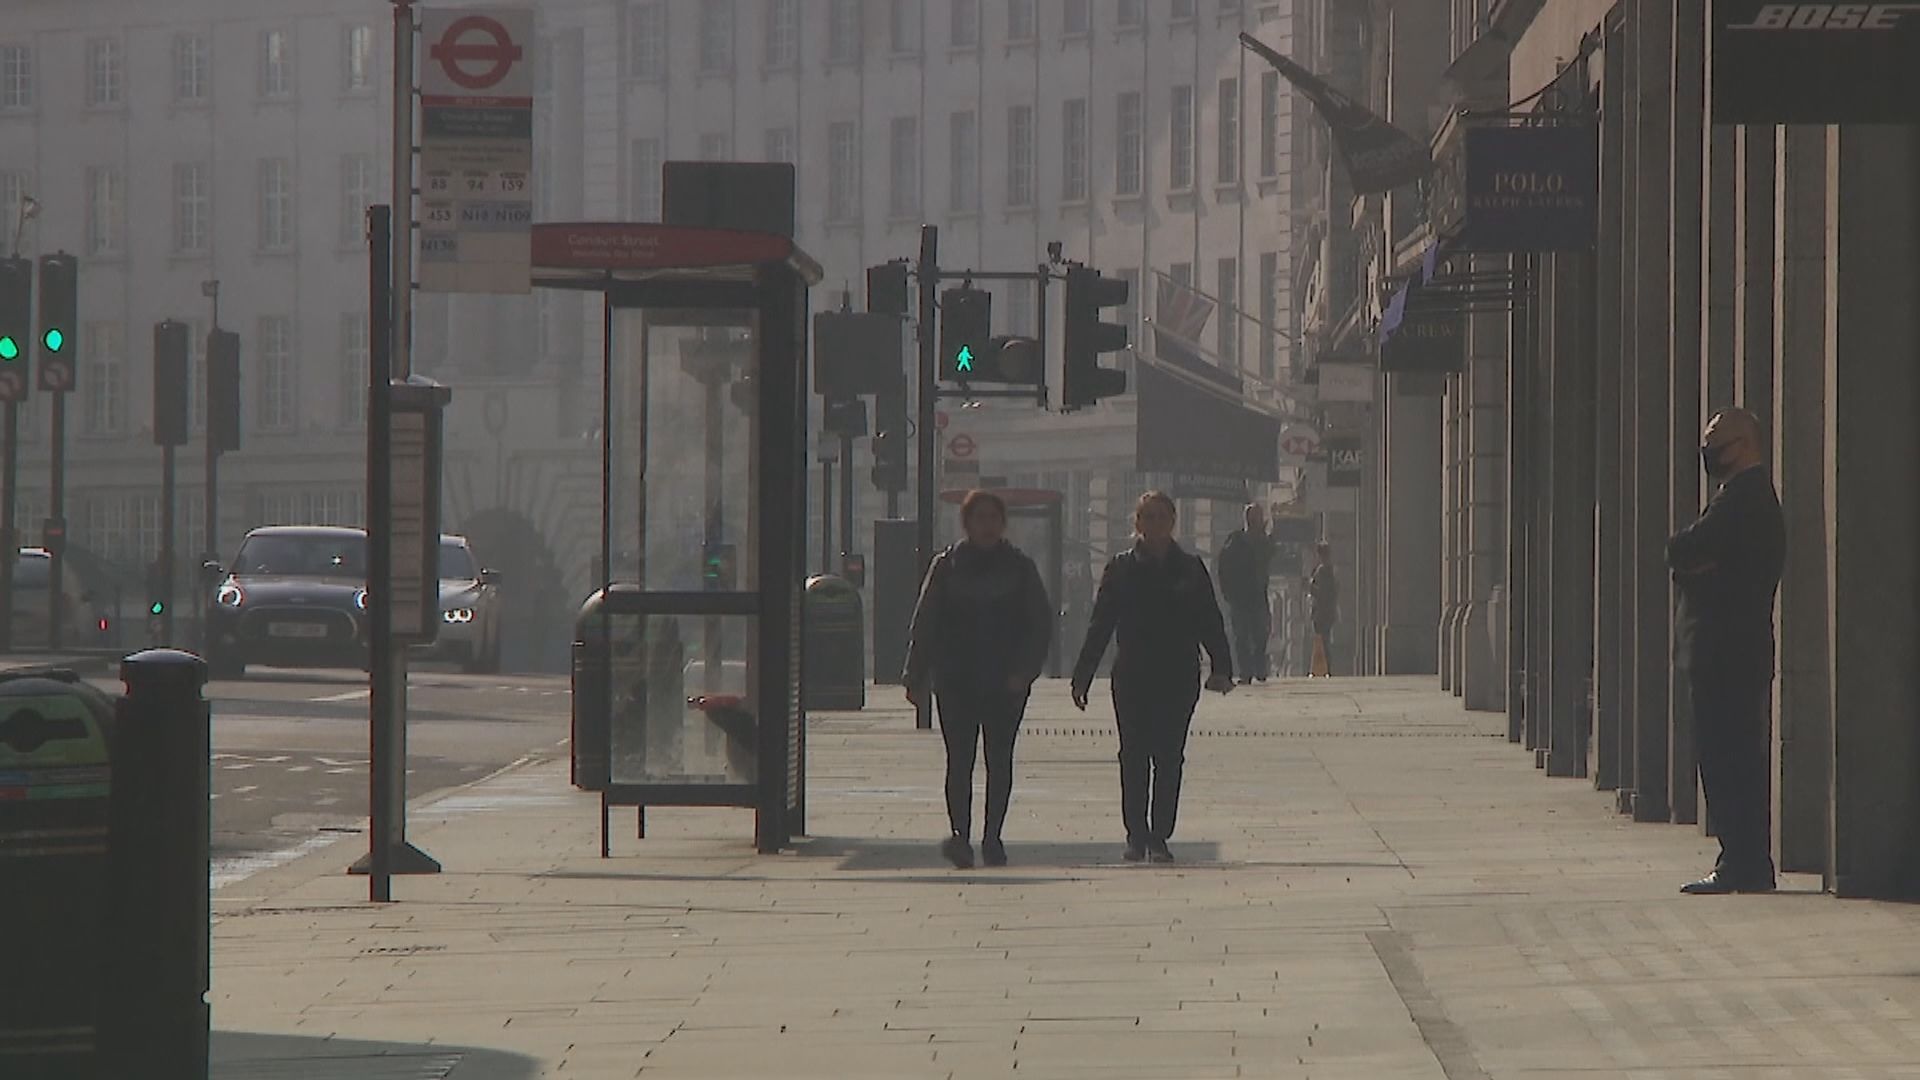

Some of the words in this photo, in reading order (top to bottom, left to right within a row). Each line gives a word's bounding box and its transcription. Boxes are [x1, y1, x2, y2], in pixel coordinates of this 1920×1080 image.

[1740, 4, 1906, 31] BOSE
[1494, 171, 1563, 193] POLO
[1472, 196, 1520, 209] RALPH
[1526, 196, 1584, 209] LAUREN
